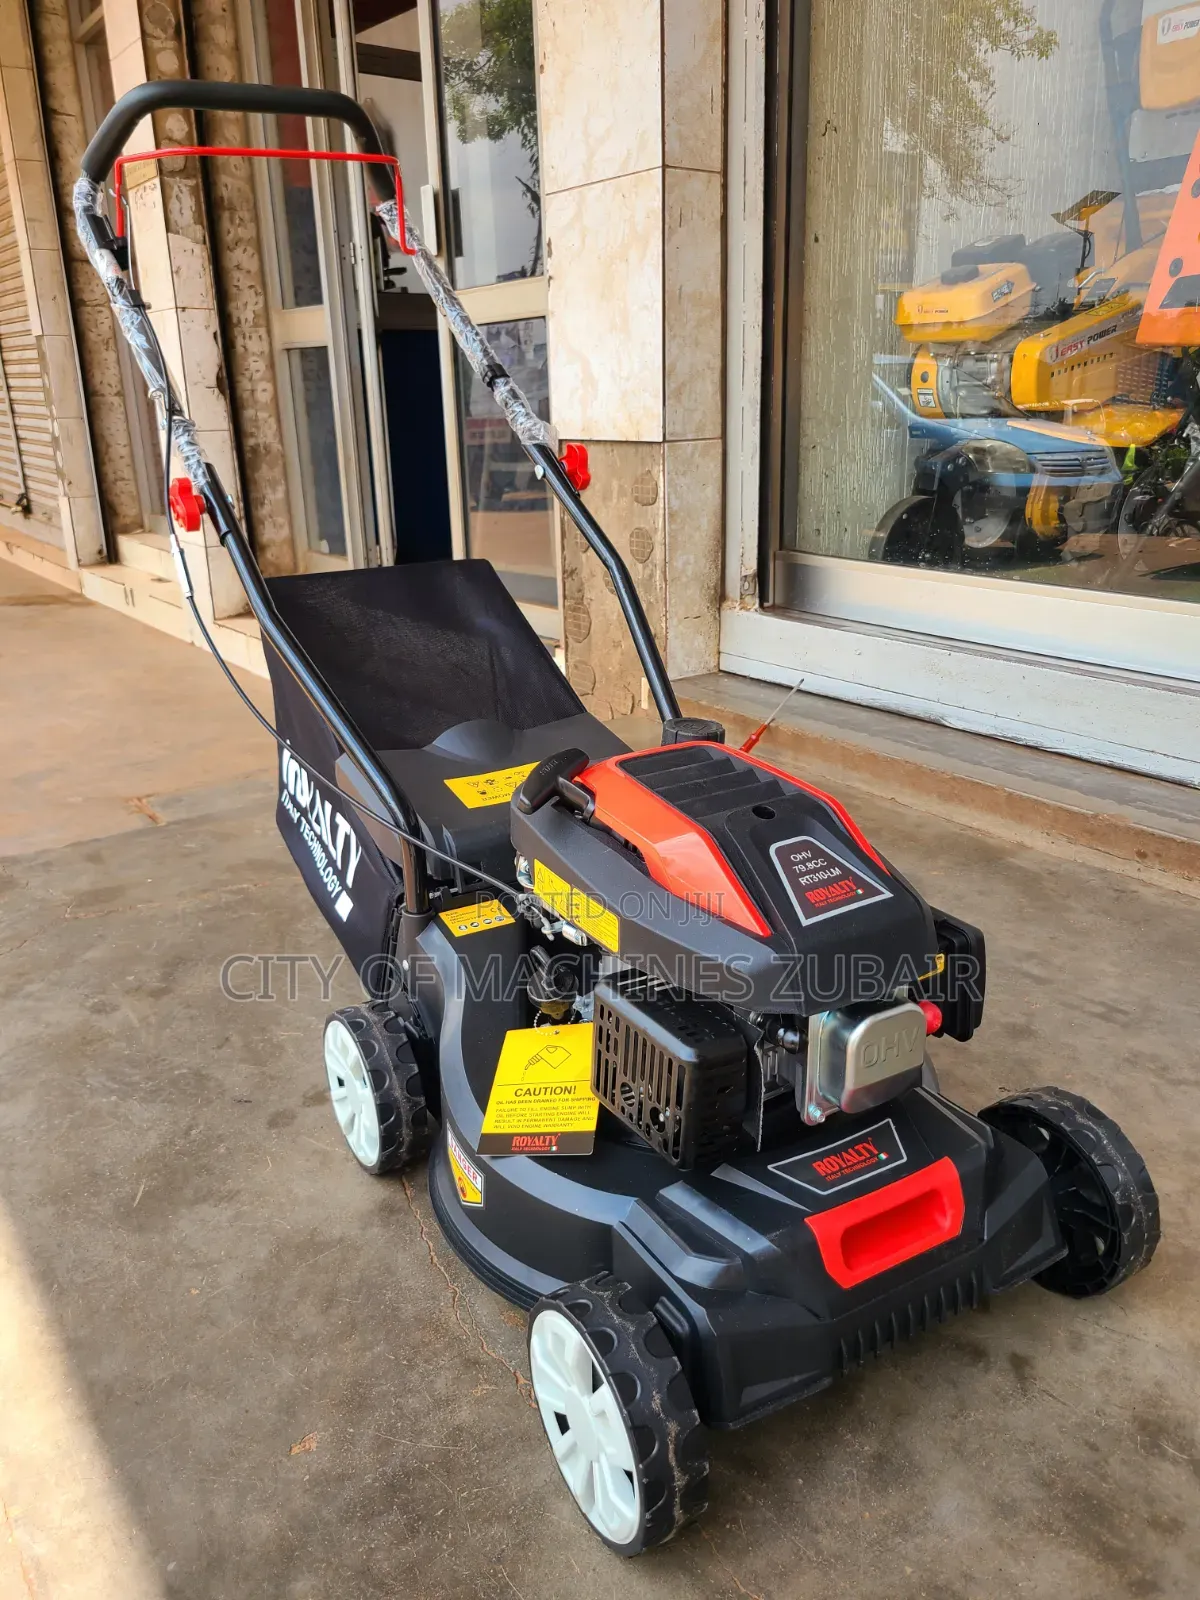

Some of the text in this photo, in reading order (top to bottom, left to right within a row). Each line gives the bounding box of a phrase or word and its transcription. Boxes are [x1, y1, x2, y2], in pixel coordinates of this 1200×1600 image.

[1087, 324, 1117, 345] POWER
[300, 816, 343, 899] TECHNOLOGY
[790, 850, 813, 863] OHV
[792, 858, 828, 874] 79.8CC
[798, 866, 843, 887] RT310-LM
[804, 877, 857, 904] ROYALTY
[860, 1026, 920, 1069] OHV
[514, 1085, 577, 1097] CAUTION!
[511, 1134, 560, 1147] ROYALTY
[449, 1136, 479, 1186] DANGER
[812, 1138, 879, 1176] ROYALTY
[825, 1157, 879, 1182] ITALY TECHNOLOGY
